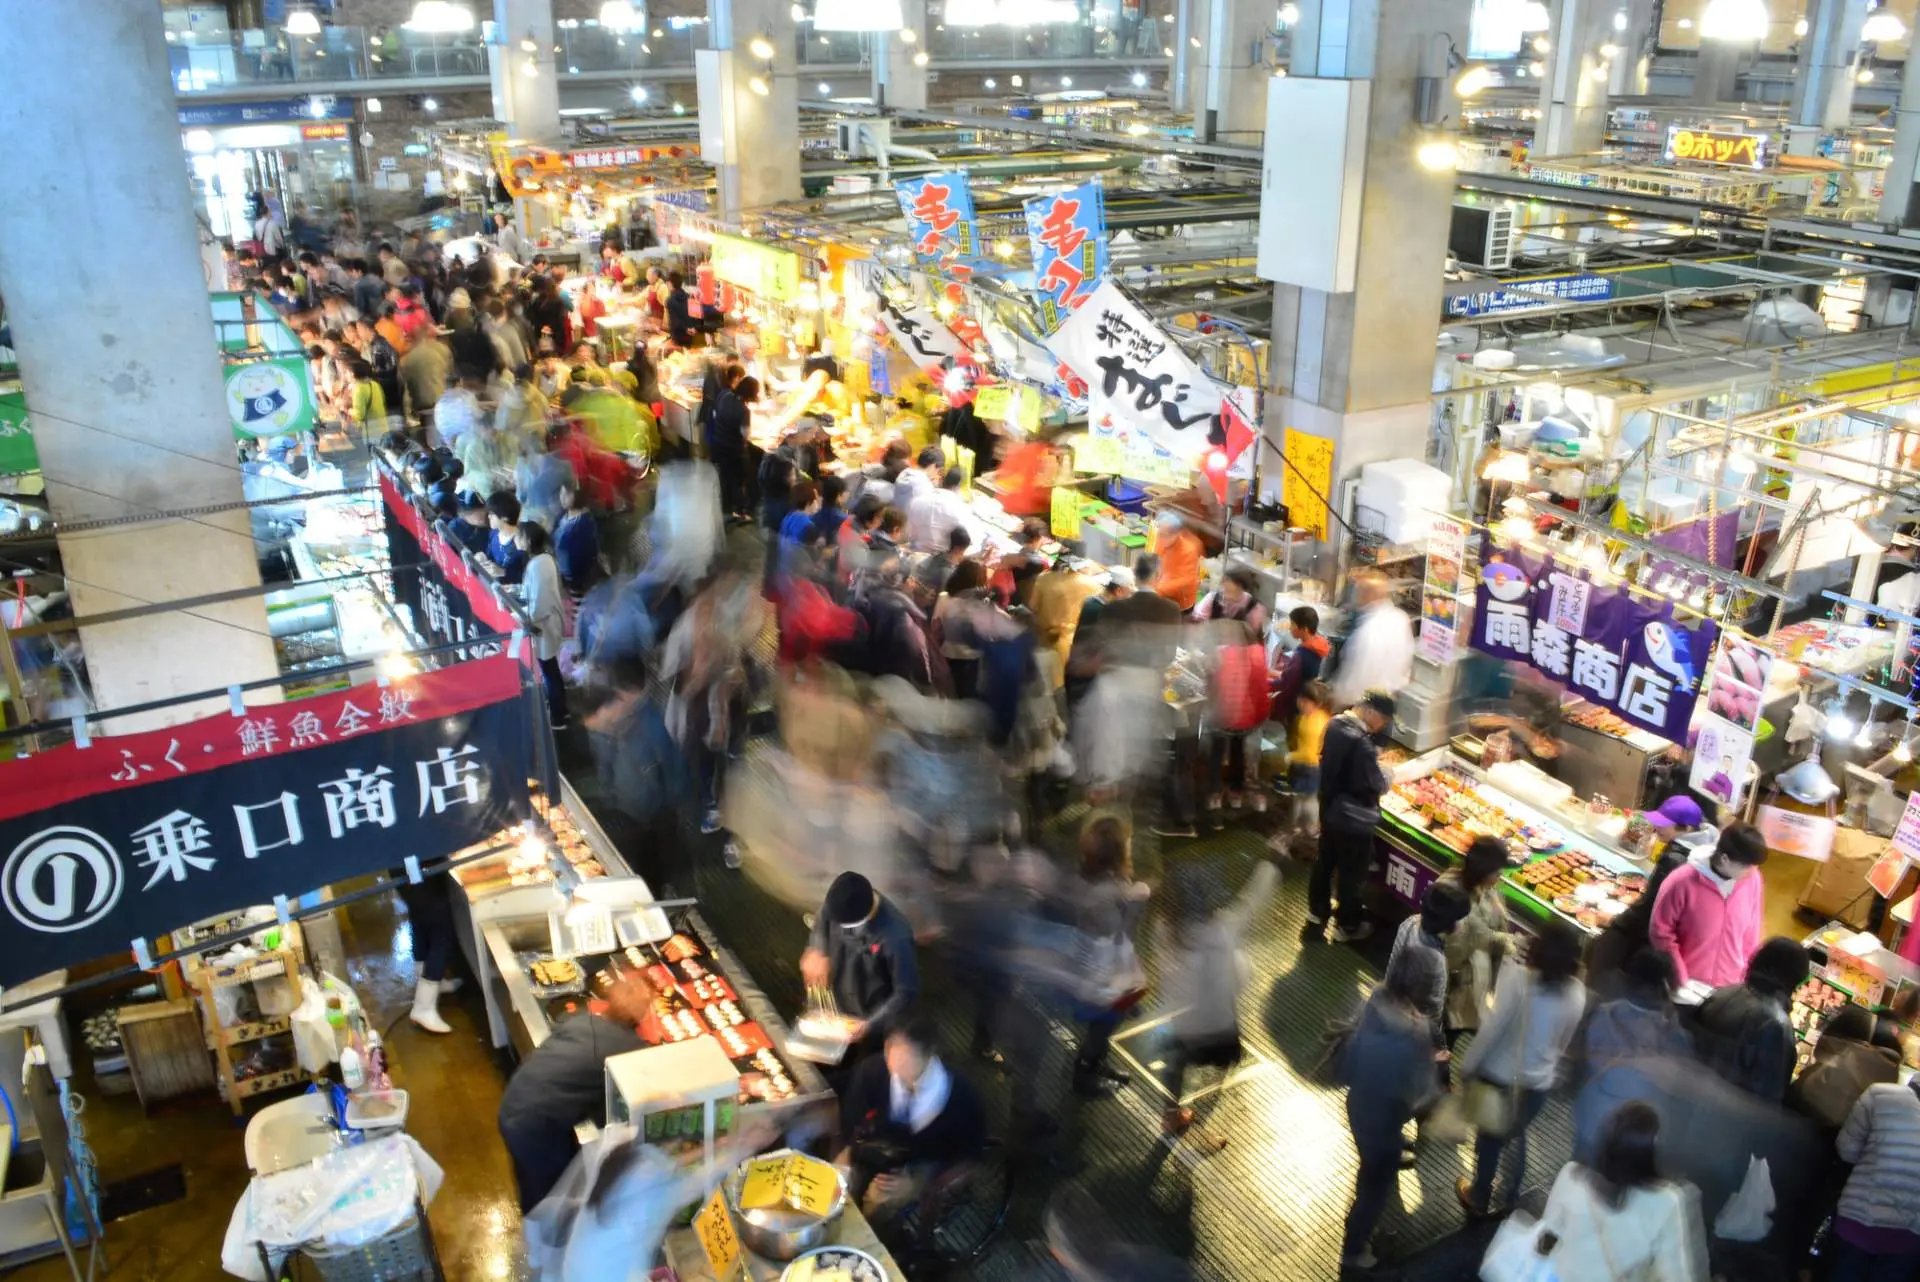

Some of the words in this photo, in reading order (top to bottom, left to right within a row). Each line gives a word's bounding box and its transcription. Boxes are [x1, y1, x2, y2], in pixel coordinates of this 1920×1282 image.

[1485, 599, 1674, 729] 雨森商店
[131, 743, 481, 892] 乗口商店
